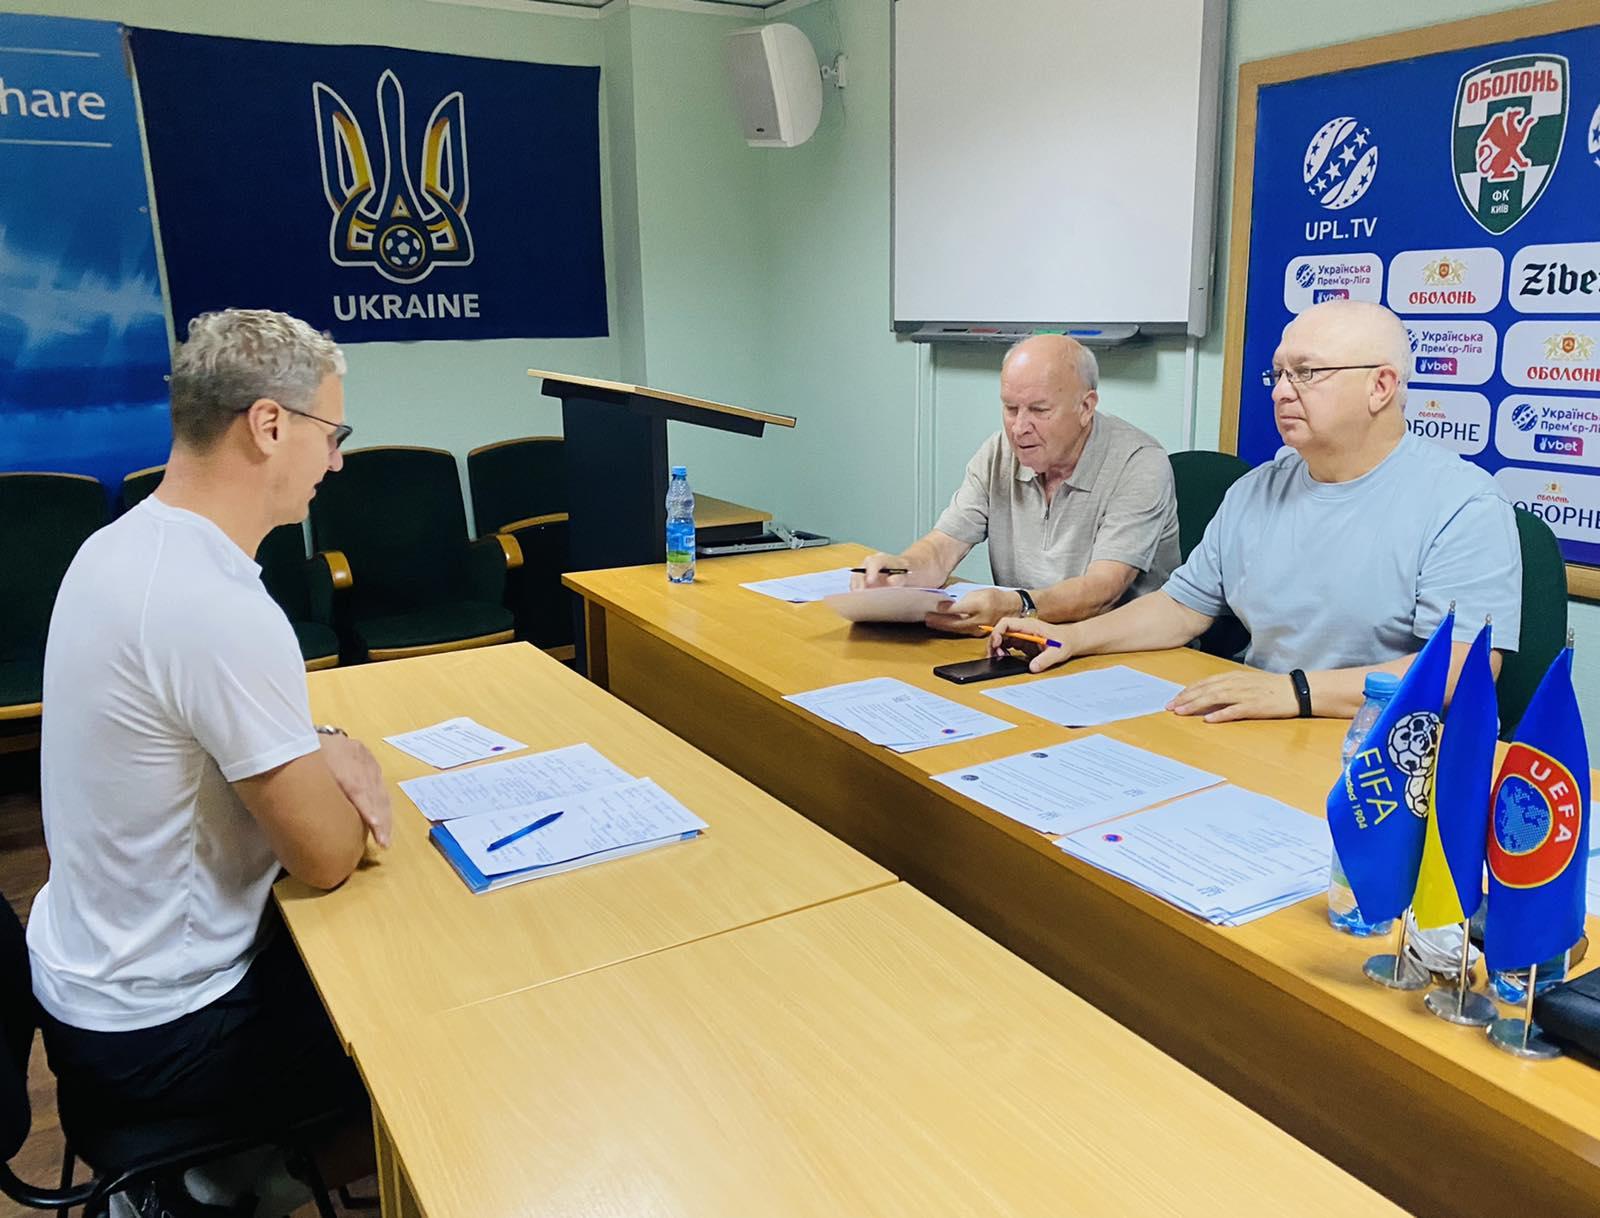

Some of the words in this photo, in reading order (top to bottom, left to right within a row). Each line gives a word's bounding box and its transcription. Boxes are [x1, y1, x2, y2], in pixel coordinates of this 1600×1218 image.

[1467, 70, 1560, 104] ОБОЛОНЬ
[0, 77, 106, 120] hare
[1492, 189, 1510, 201] ФК
[1305, 217, 1378, 241] UPL.TV
[1318, 264, 1371, 275] Українська
[1519, 262, 1600, 297] Zibe
[333, 293, 481, 322] UKRAINE
[1409, 291, 1476, 305] ОБОЛОНЬ
[1421, 331, 1483, 343] Українська
[1427, 360, 1453, 371] vbet
[1541, 407, 1600, 421] Українсь
[1548, 440, 1578, 452] vbet
[1355, 747, 1398, 825] FIFA
[1530, 760, 1575, 843] UEFA
